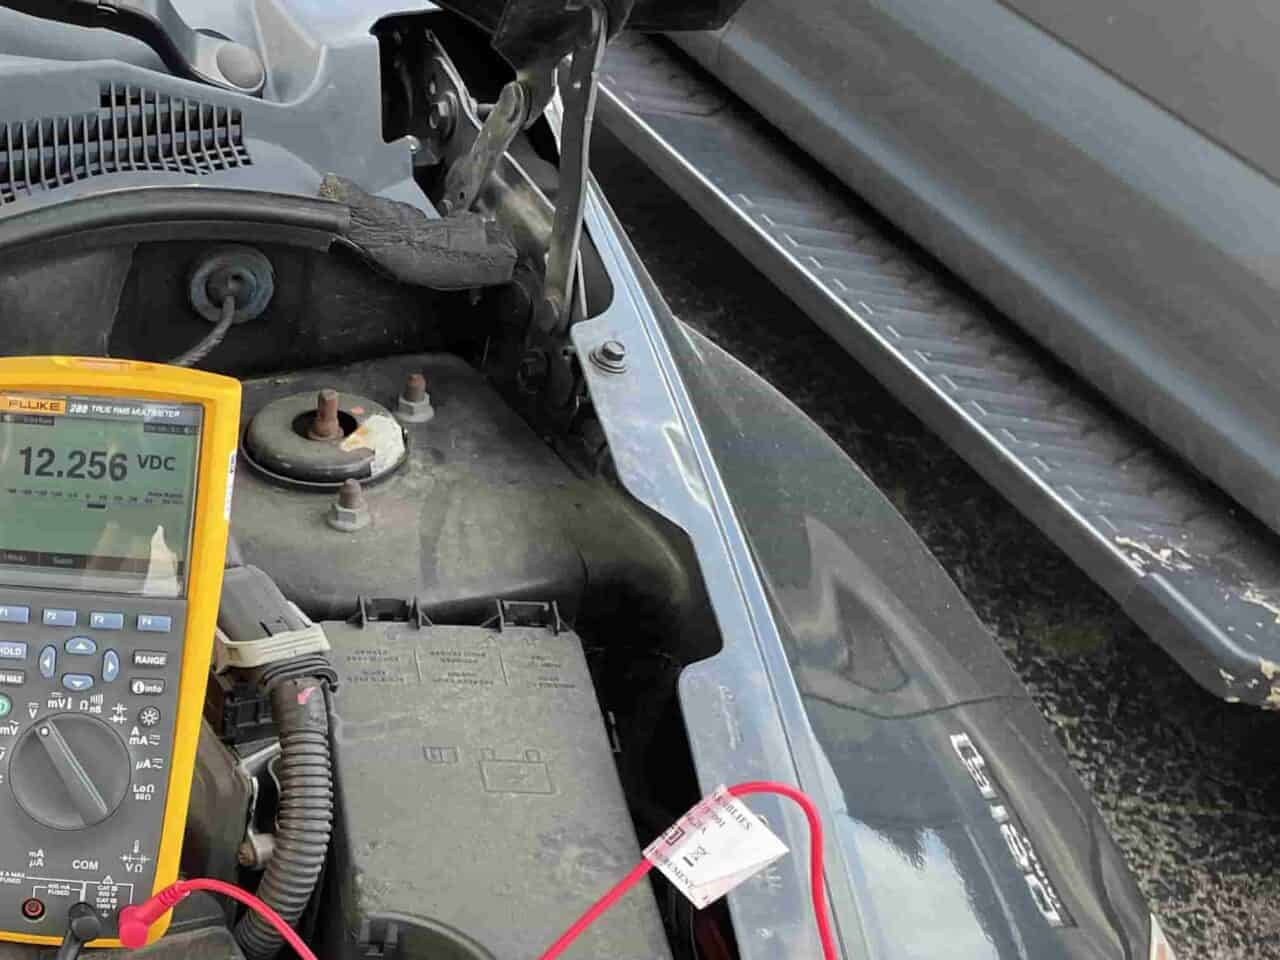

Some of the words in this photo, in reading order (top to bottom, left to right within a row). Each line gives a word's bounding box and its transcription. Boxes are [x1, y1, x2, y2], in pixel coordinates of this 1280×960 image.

[8, 400, 61, 411] FLUKE
[19, 446, 128, 481] 12.256
[137, 455, 176, 472] VDC
[134, 655, 167, 665] RANGE
[72, 860, 99, 870] COM
